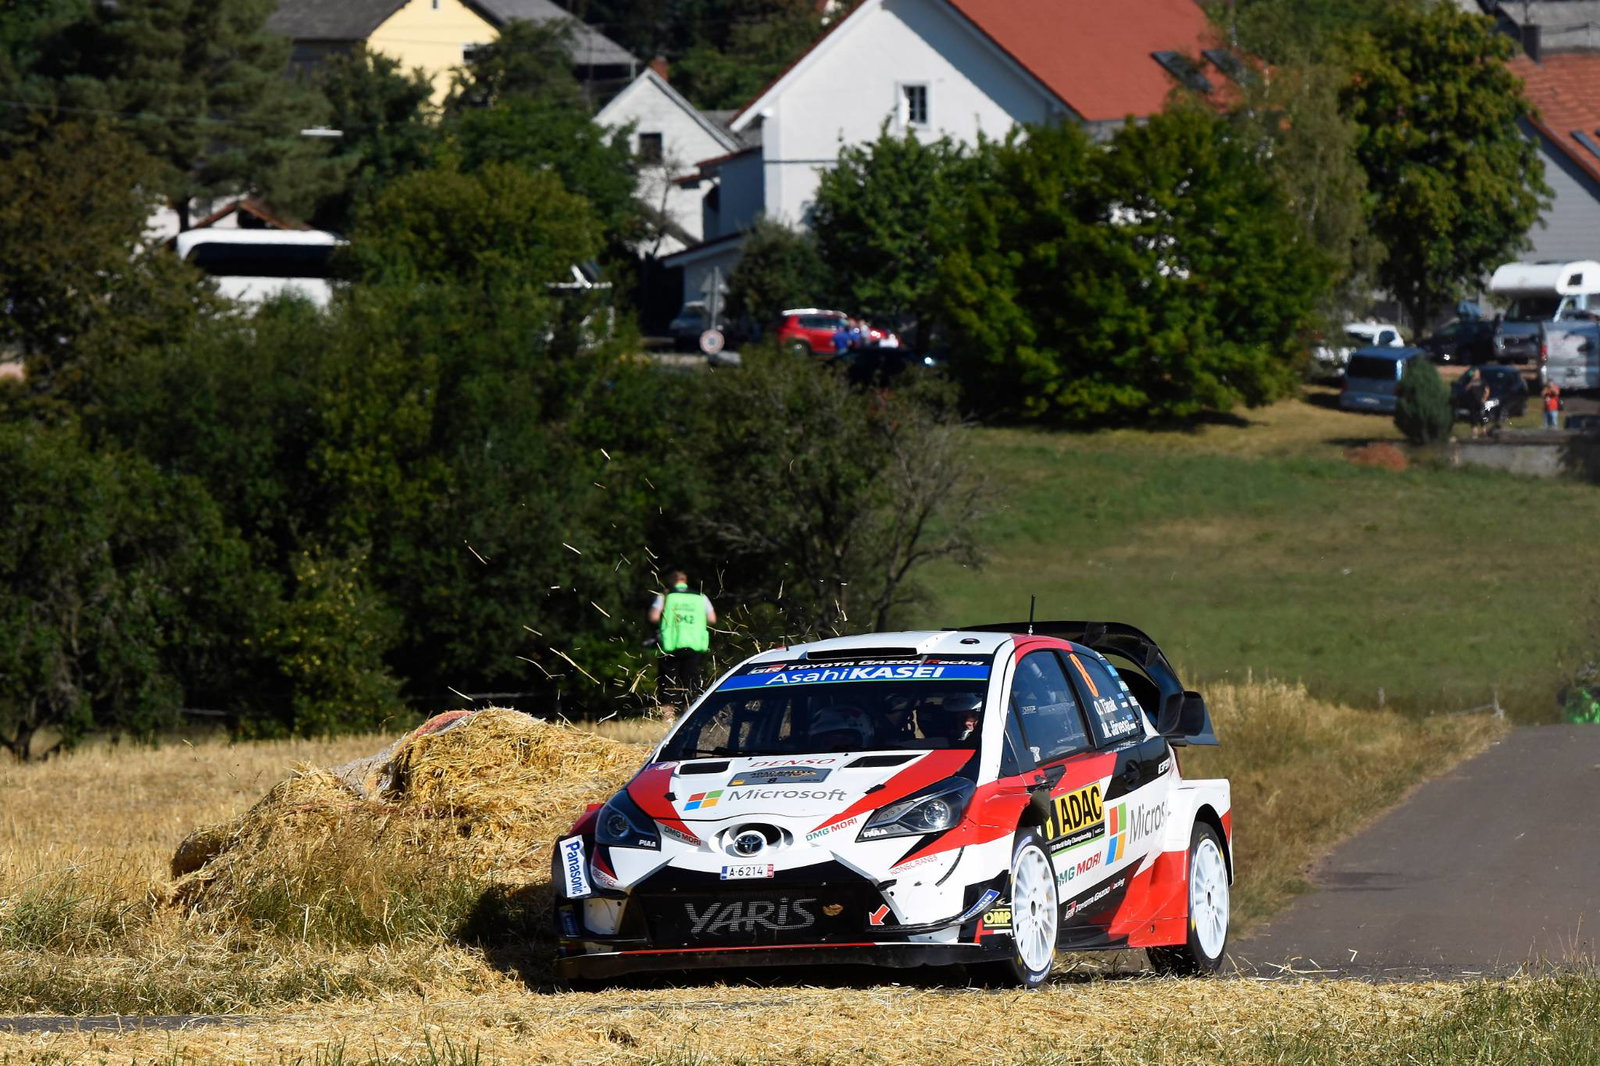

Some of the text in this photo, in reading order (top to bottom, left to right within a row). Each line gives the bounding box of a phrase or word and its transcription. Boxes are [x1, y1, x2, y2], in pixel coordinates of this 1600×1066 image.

[787, 661, 854, 671] TOYOTA
[749, 758, 836, 768] DENSO
[728, 789, 847, 802] Microsoft
[1060, 785, 1102, 833] ADAC
[805, 817, 858, 842] DMG MORI
[565, 841, 584, 895] Panasonic
[1076, 851, 1101, 876] MORI
[983, 911, 1012, 924] OMP
